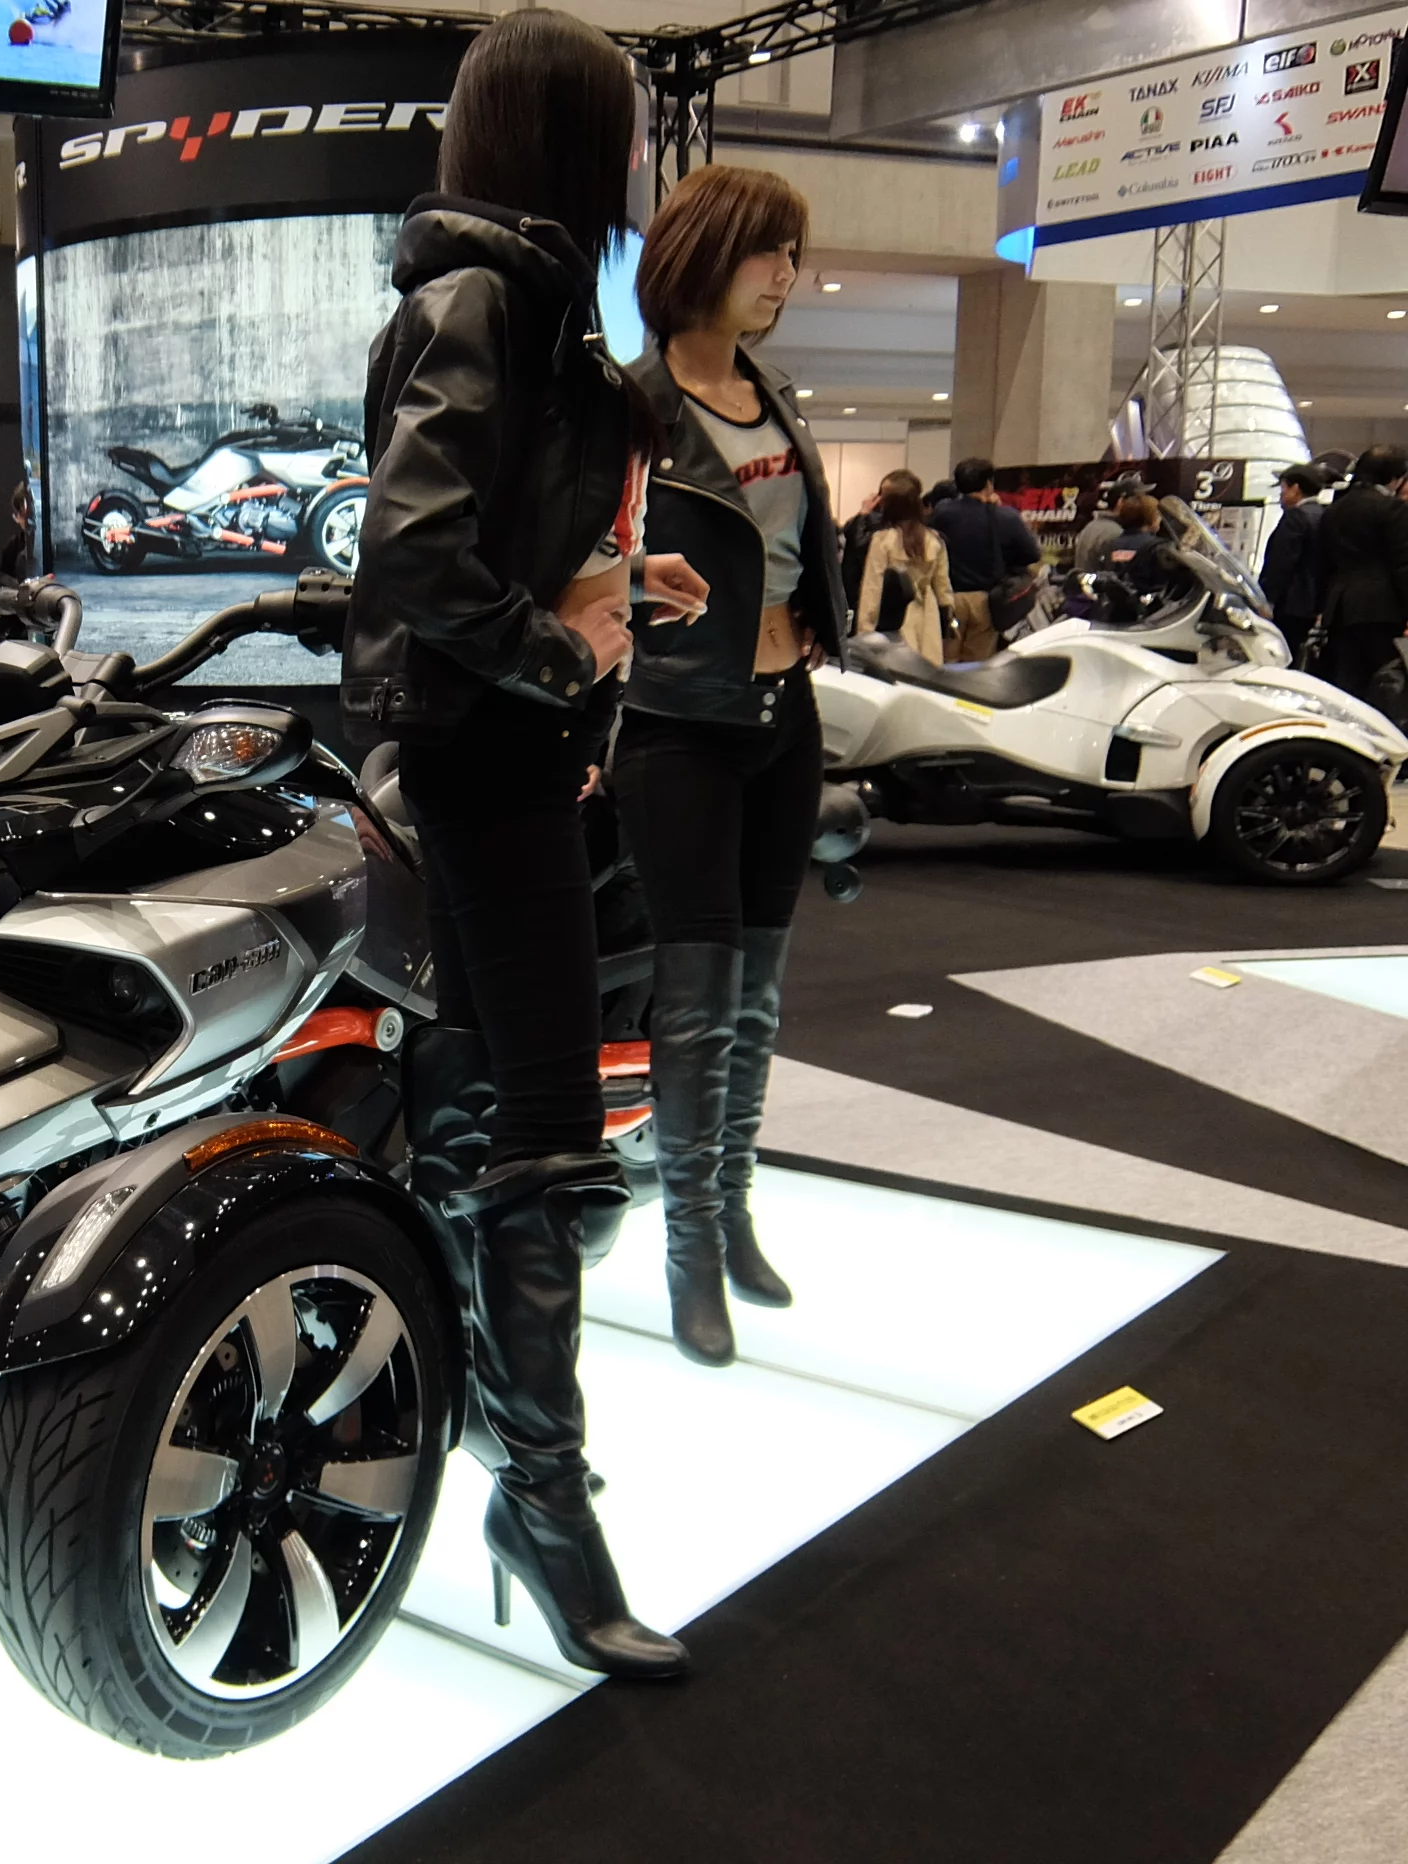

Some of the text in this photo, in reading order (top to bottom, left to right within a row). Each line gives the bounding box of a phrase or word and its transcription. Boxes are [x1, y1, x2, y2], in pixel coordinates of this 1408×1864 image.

[1266, 49, 1297, 73] elf
[1192, 62, 1249, 88] KIJIMA
[1128, 77, 1179, 102] TANAX
[1200, 94, 1236, 118] SFJ
[59, 101, 449, 170] SPYDER
[1189, 132, 1239, 153] PIAA
[1120, 141, 1181, 162] ACTIVE
[1052, 158, 1100, 180] LEAD
[1193, 165, 1233, 184] EIGHT
[1128, 178, 1179, 196] Columbia
